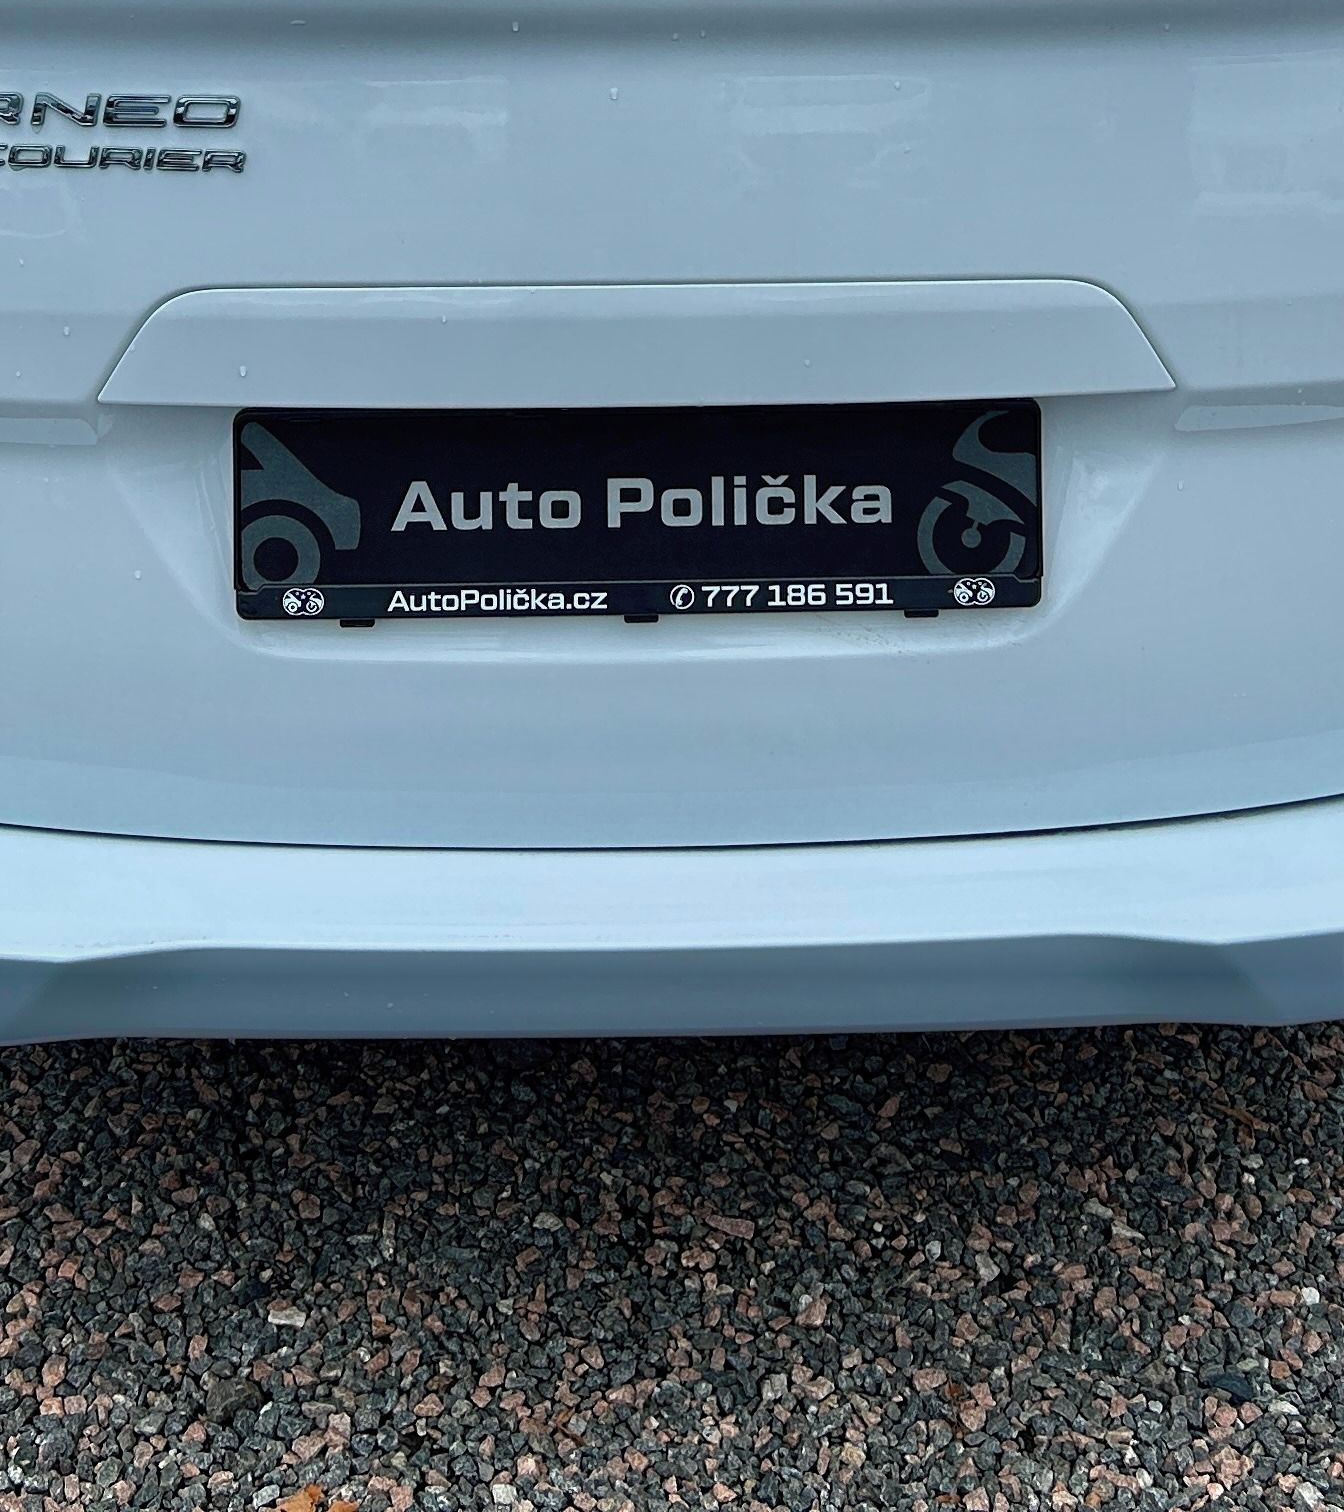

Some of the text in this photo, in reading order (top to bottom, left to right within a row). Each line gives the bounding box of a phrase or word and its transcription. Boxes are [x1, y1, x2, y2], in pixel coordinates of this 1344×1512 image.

[390, 474, 893, 531] Auto Polička
[387, 588, 608, 613] AutoPolička.cz
[701, 582, 894, 608] 777 186 591
